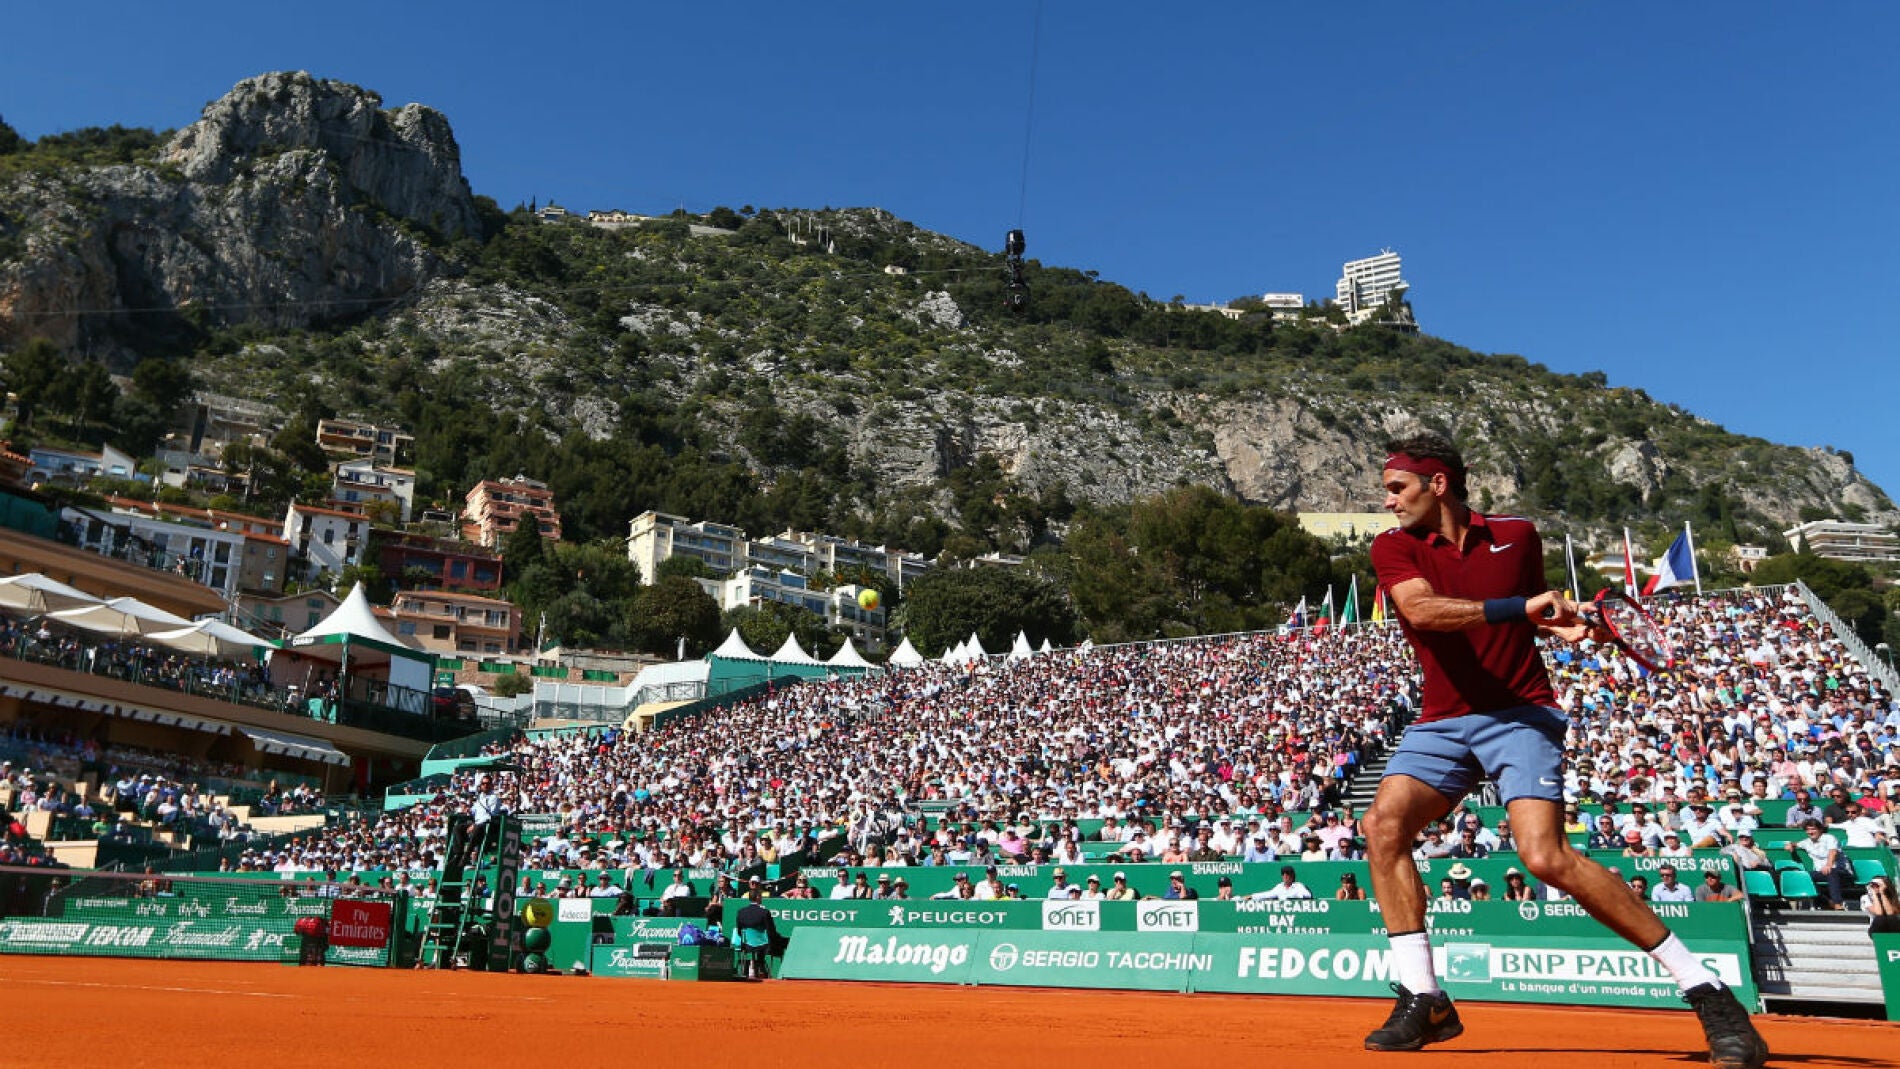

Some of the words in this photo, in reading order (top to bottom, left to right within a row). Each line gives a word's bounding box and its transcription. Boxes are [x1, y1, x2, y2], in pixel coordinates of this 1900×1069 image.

[1192, 862, 1244, 875] SHANGHAI
[1635, 858, 1697, 871] LONDRES
[1699, 858, 1730, 872] 2016
[494, 832, 520, 947] RICOH
[353, 908, 370, 924] Fly
[769, 909, 859, 922] PEUGEOT
[1236, 900, 1330, 913] MONTE-CARLO
[908, 911, 1008, 924] PEUGEOT
[1048, 907, 1097, 927] ONET
[1142, 907, 1195, 927] ONET
[1269, 914, 1296, 927] BAY
[333, 919, 385, 940] Emirates
[834, 935, 969, 974] Malongo
[1022, 950, 1100, 968] SERGIO
[1107, 951, 1214, 971] TACCHINI
[1501, 952, 1565, 975] BNP
[1501, 980, 1515, 991] La
[1519, 980, 1565, 994] banque
[1568, 982, 1597, 993] d'un
[1601, 983, 1646, 997] monde
[1649, 985, 1671, 1000] qui
